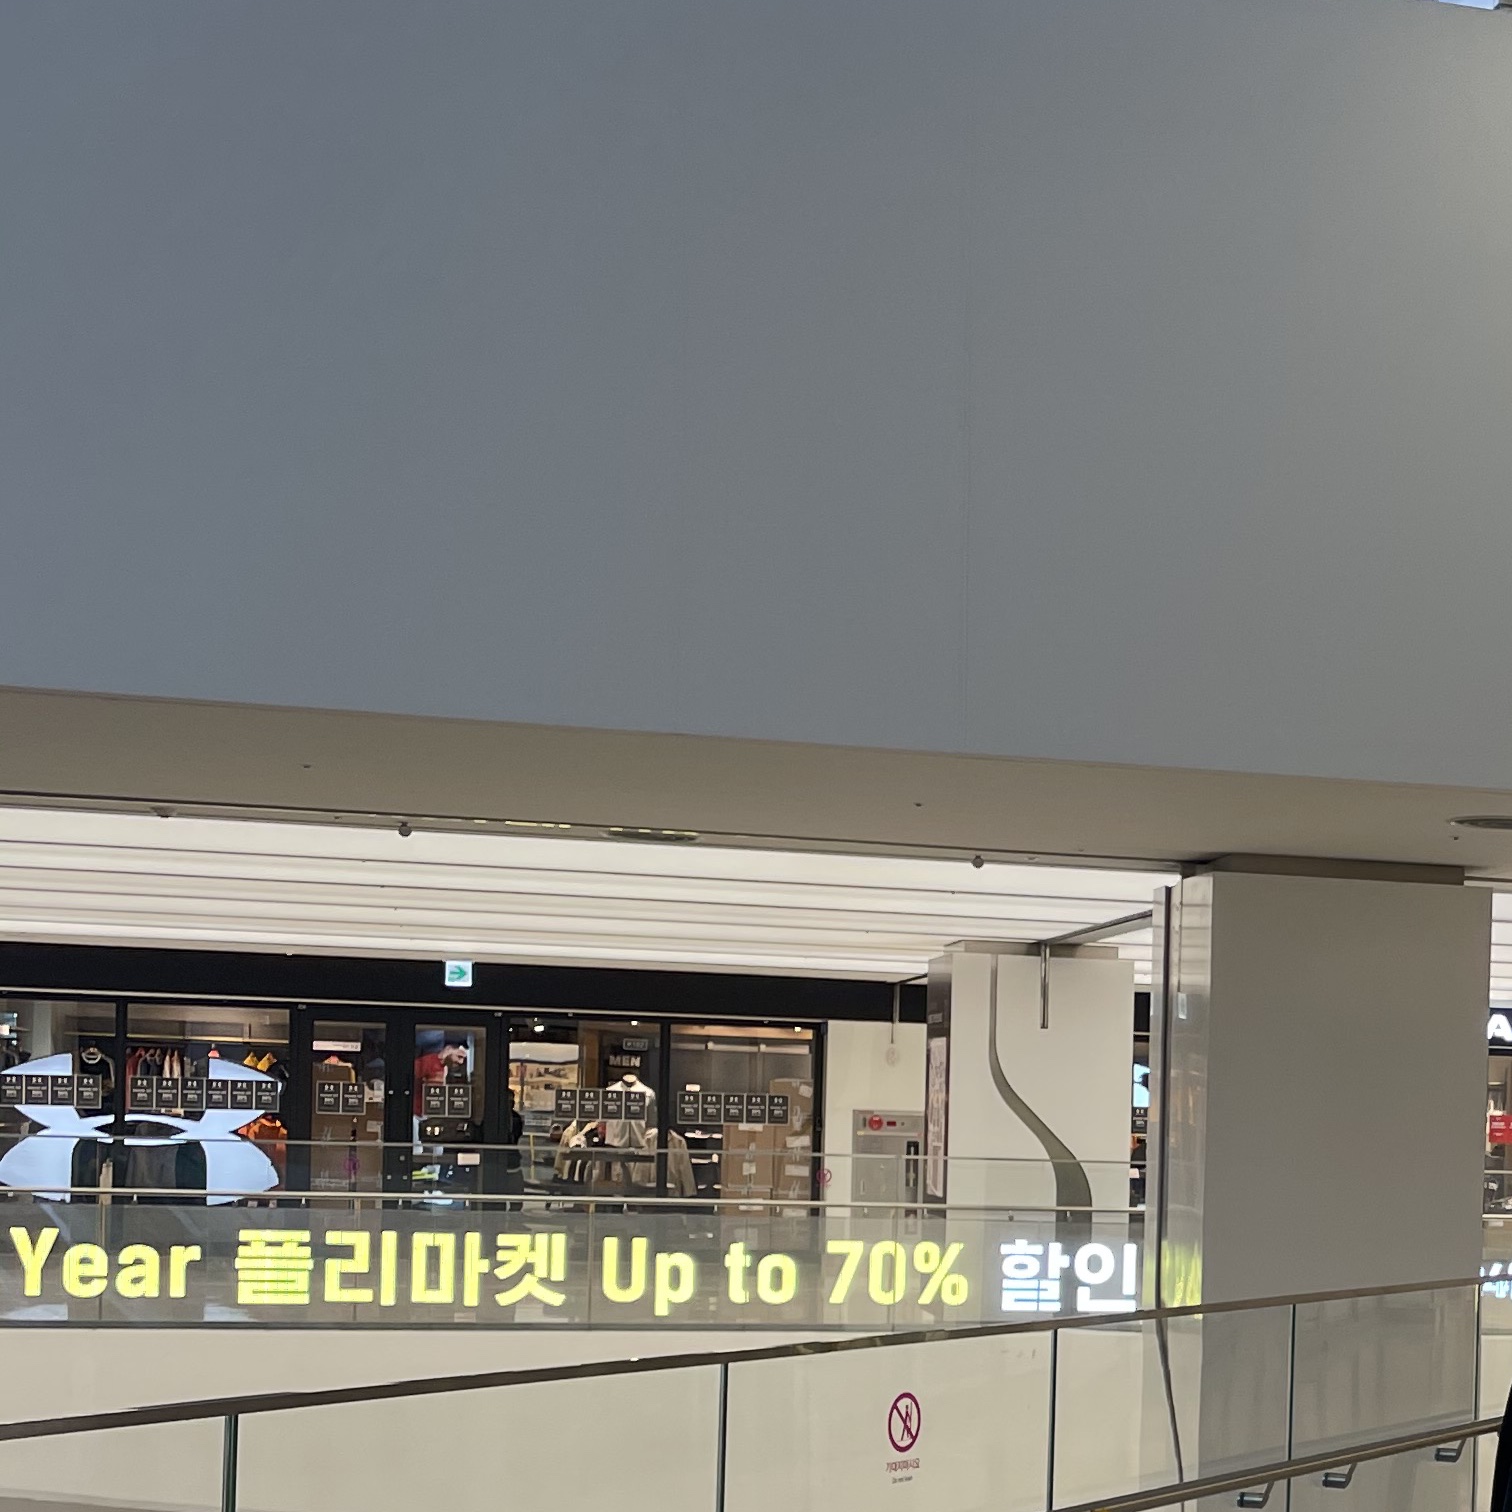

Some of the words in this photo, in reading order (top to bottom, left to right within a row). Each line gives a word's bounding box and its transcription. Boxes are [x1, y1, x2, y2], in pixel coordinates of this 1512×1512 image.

[609, 1055, 641, 1067] MEN
[9, 1226, 201, 1299] Year
[235, 1228, 568, 1308] 플리마켓
[602, 1235, 695, 1316] Up
[724, 1241, 797, 1305] to
[826, 1240, 969, 1306] 70%
[999, 1238, 1138, 1313] 할인
